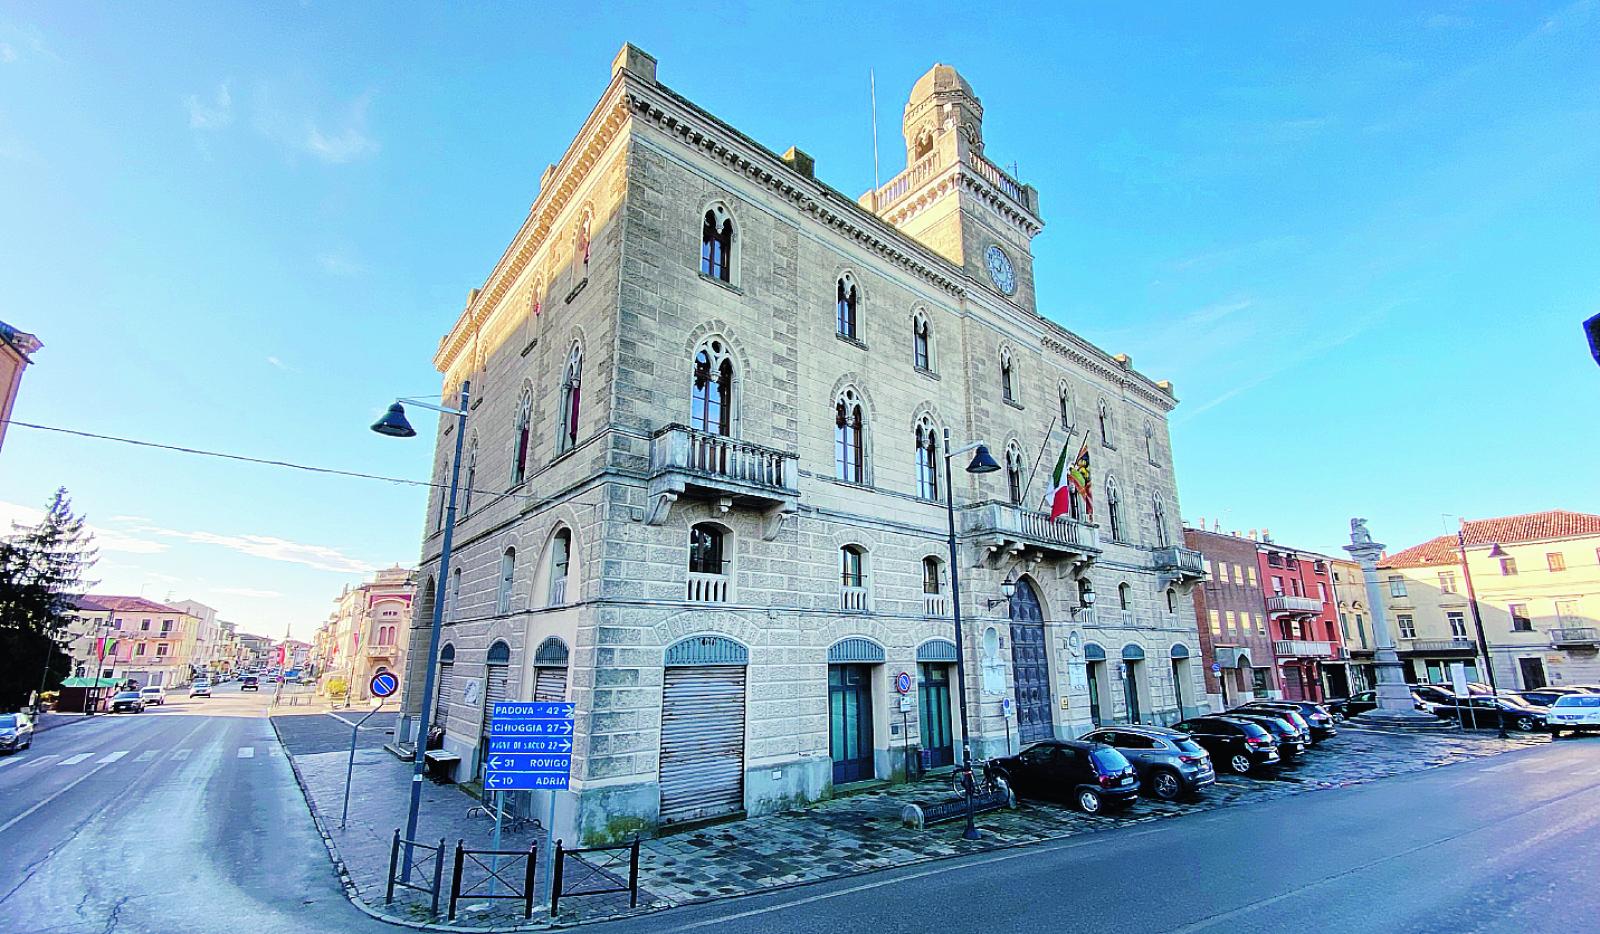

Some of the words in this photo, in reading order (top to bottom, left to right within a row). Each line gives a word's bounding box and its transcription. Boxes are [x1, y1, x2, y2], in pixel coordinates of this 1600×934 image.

[495, 706, 534, 715] PADOVA
[546, 706, 560, 714] 42
[494, 724, 543, 732] CHIOGGIA
[546, 724, 560, 732] 27
[530, 760, 568, 768] ROVIGO
[503, 777, 514, 785] 10
[536, 777, 566, 785] ADRIA
